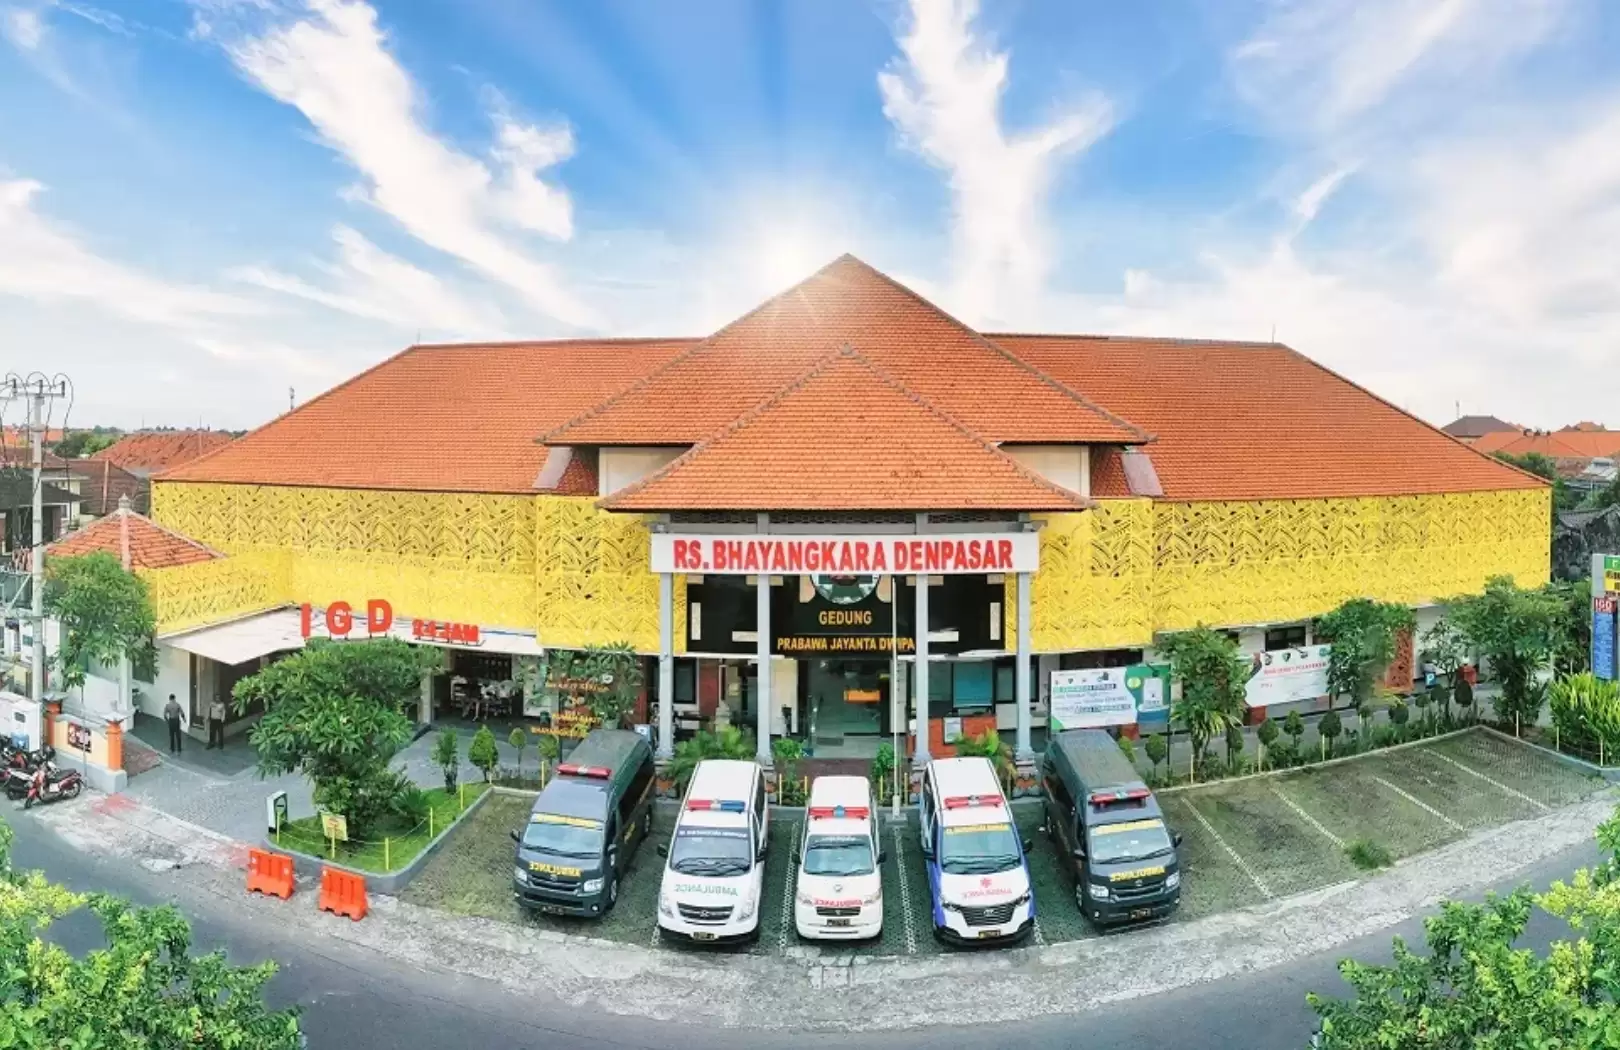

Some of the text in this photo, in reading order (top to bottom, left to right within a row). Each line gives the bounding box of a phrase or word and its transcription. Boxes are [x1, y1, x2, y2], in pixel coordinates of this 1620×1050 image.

[893, 539, 1013, 571] DENPASAR
[818, 610, 873, 626] GEDUNG
[777, 637, 828, 650] PRABAWA
[830, 637, 878, 650] JAYANTA
